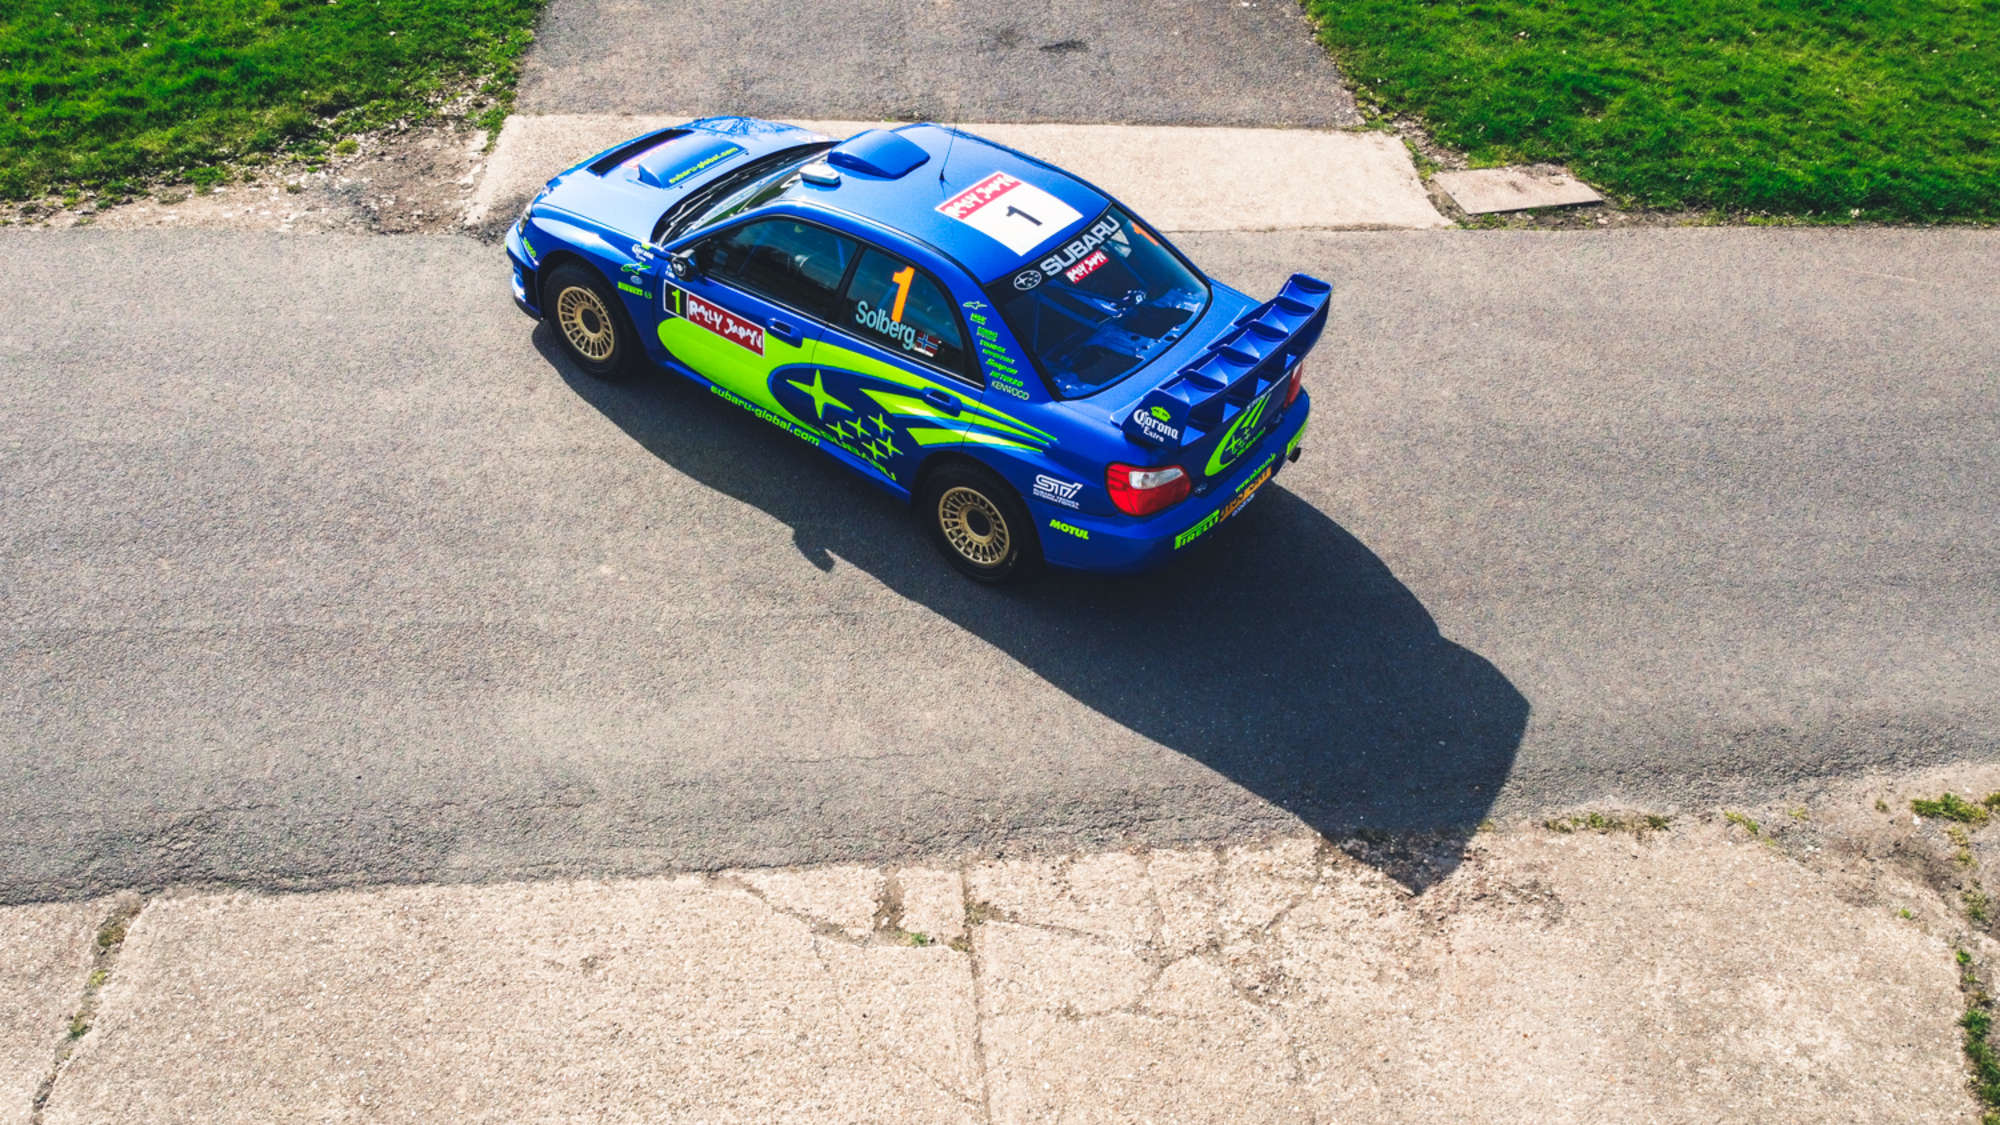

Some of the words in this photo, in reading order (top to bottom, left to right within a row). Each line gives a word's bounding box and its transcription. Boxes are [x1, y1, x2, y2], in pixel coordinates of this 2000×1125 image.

[1005, 204, 1043, 226] 1
[1039, 215, 1120, 276] SUBARU
[671, 288, 681, 315] 1
[892, 265, 915, 324] 1
[855, 300, 916, 350] Solberg
[991, 380, 1030, 401] KENWOOD
[710, 385, 820, 446] subaru-global.com
[1133, 409, 1178, 440] Corona
[1143, 426, 1165, 442] Extra
[1049, 519, 1089, 540] MOTUL
[1174, 509, 1220, 550] PIRELLI
